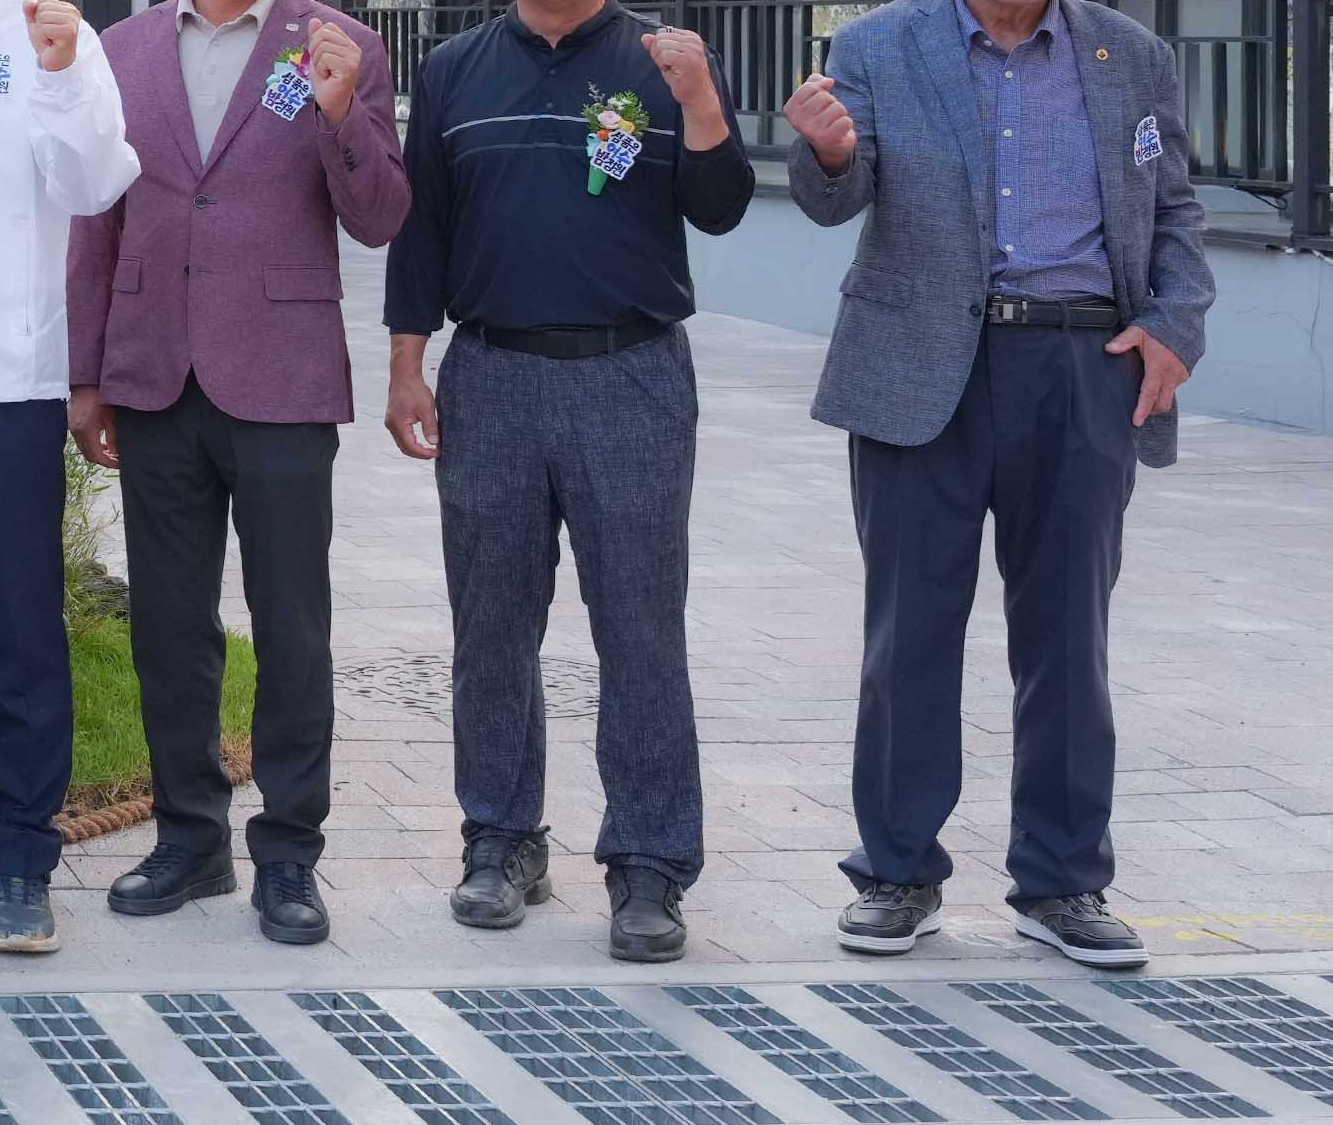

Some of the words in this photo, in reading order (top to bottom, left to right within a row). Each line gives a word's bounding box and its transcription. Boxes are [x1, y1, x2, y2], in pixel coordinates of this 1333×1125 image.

[277, 84, 303, 107] 여수
[281, 72, 309, 96] 섬품은
[265, 89, 297, 119] 밤정원
[606, 142, 632, 164] 여수
[612, 132, 640, 154] 섬품은
[594, 148, 627, 178] 밤정원
